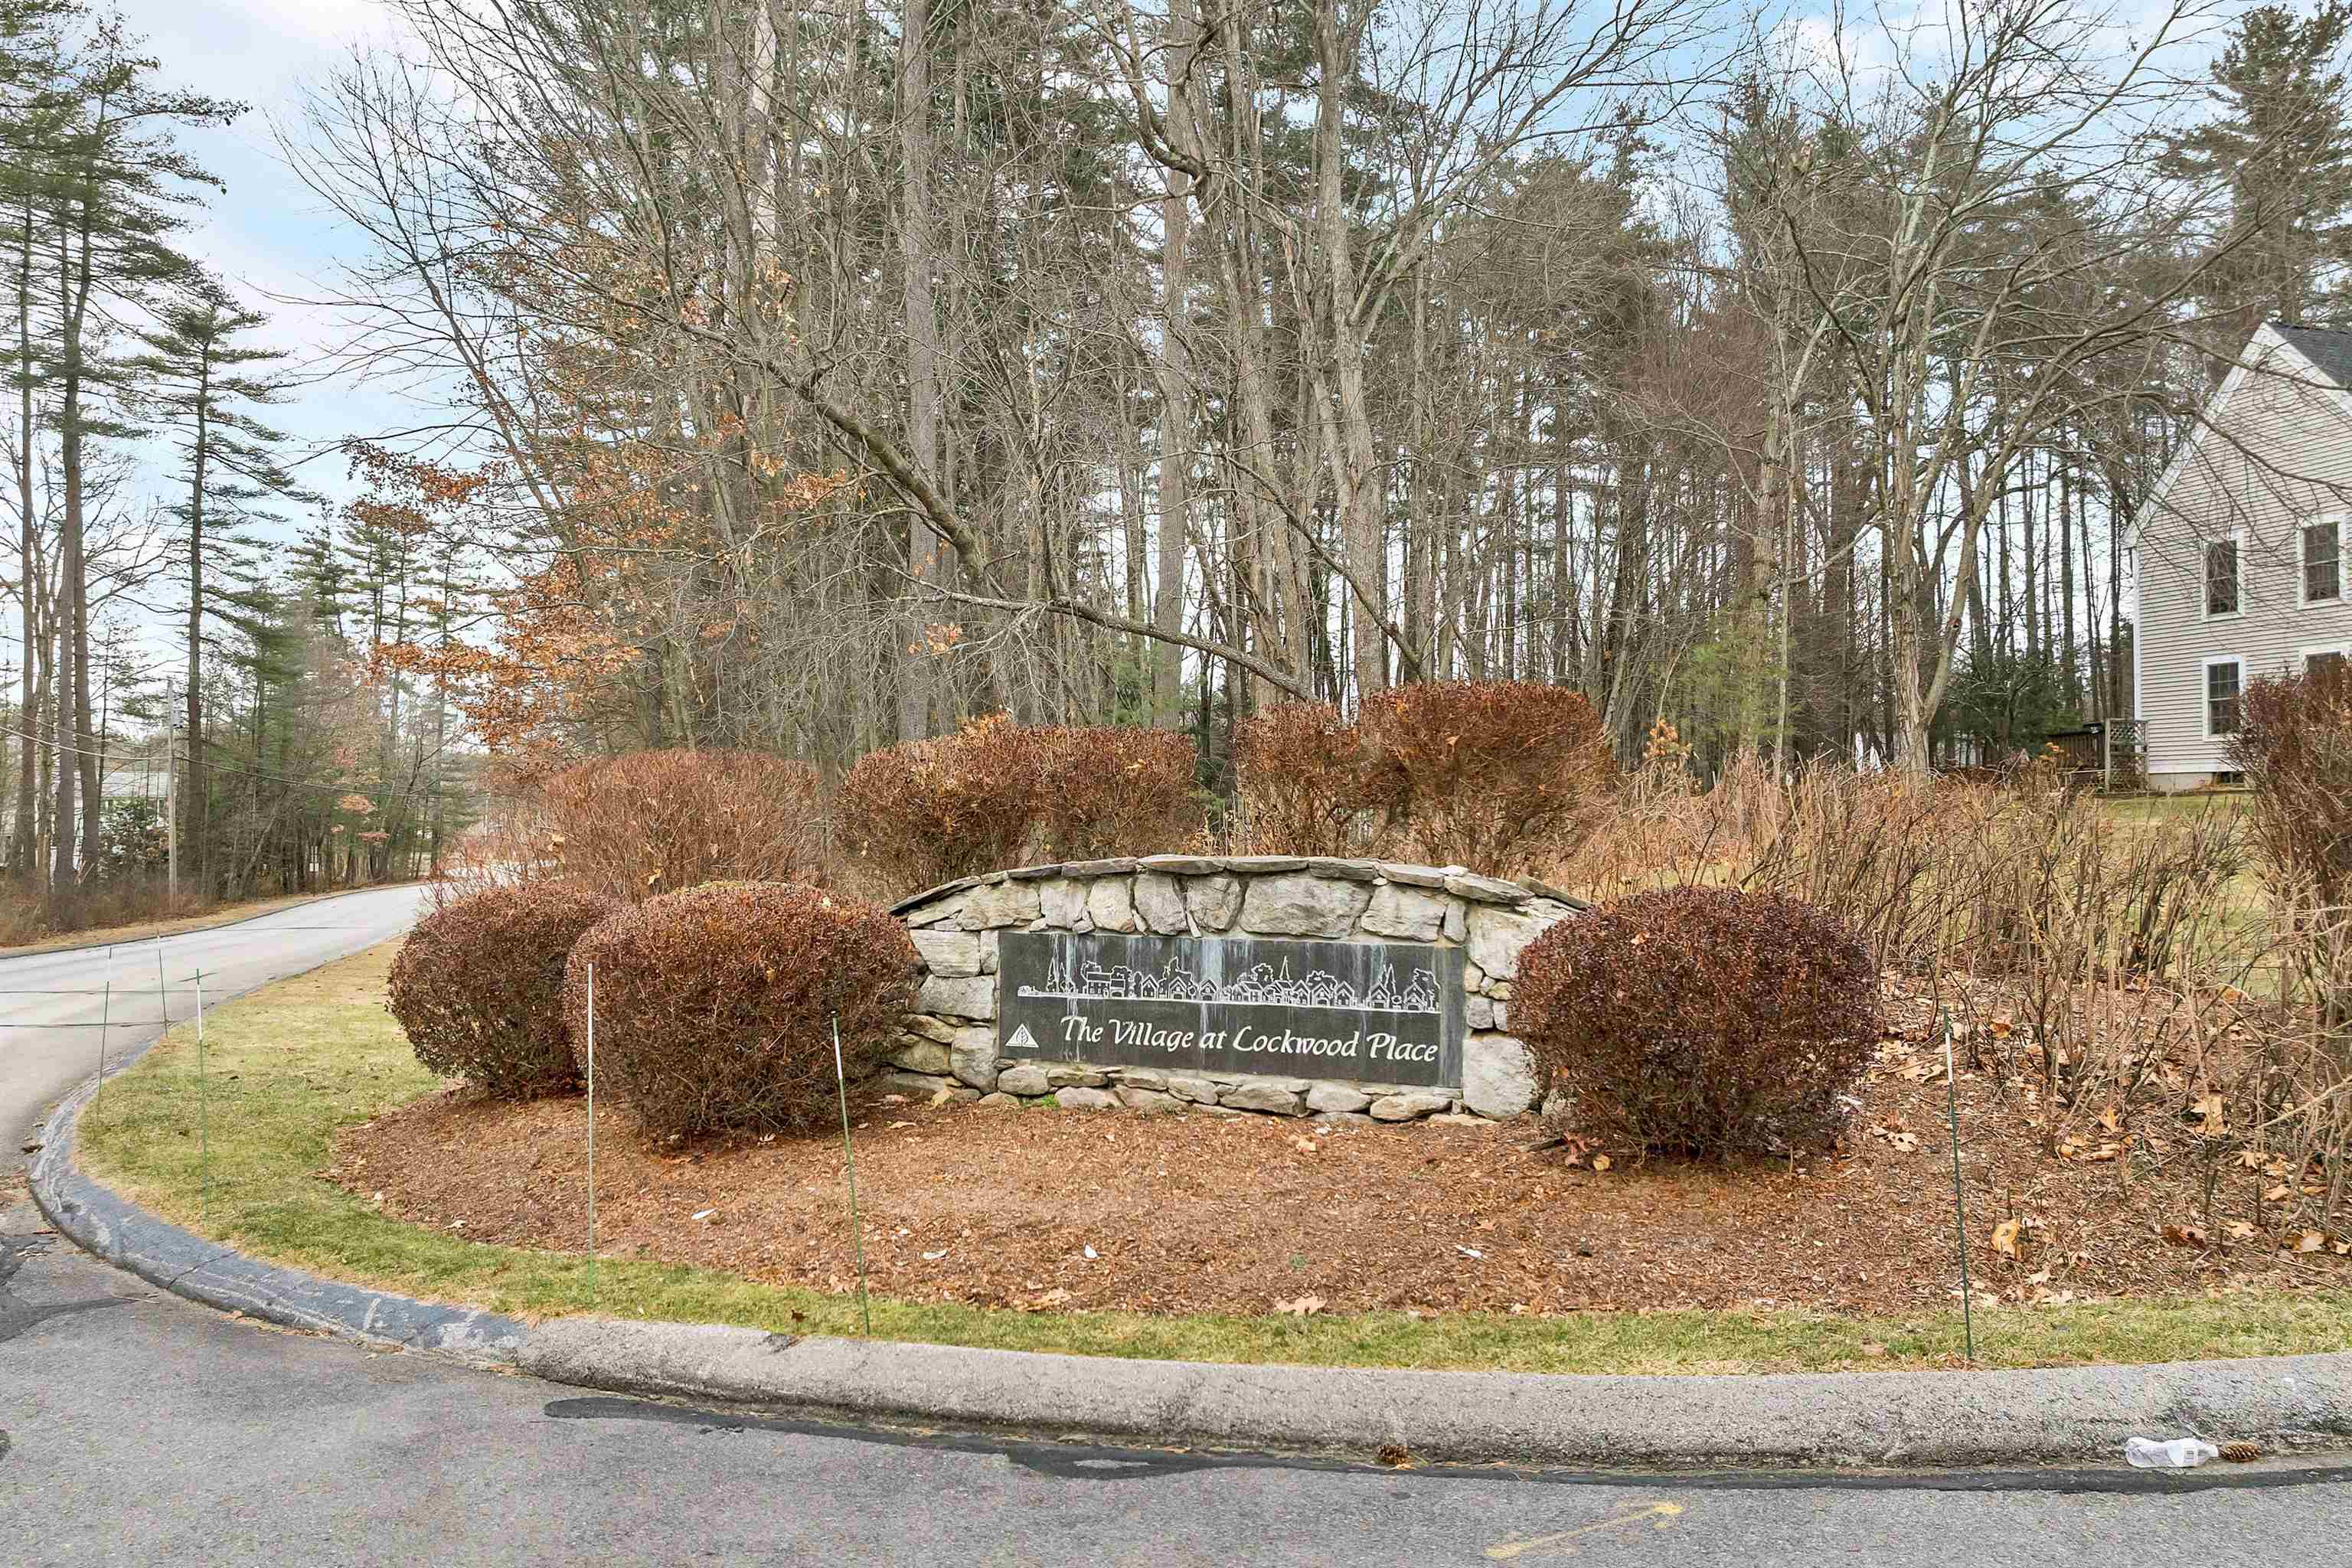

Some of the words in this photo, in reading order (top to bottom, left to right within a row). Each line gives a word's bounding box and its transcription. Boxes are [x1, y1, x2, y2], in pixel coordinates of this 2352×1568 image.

[1060, 1015, 1103, 1043] The
[1109, 1019, 1194, 1052] Village
[1200, 1029, 1227, 1050] at
[1233, 1025, 1360, 1057] Lockwood
[1367, 1032, 1439, 1062] Place
